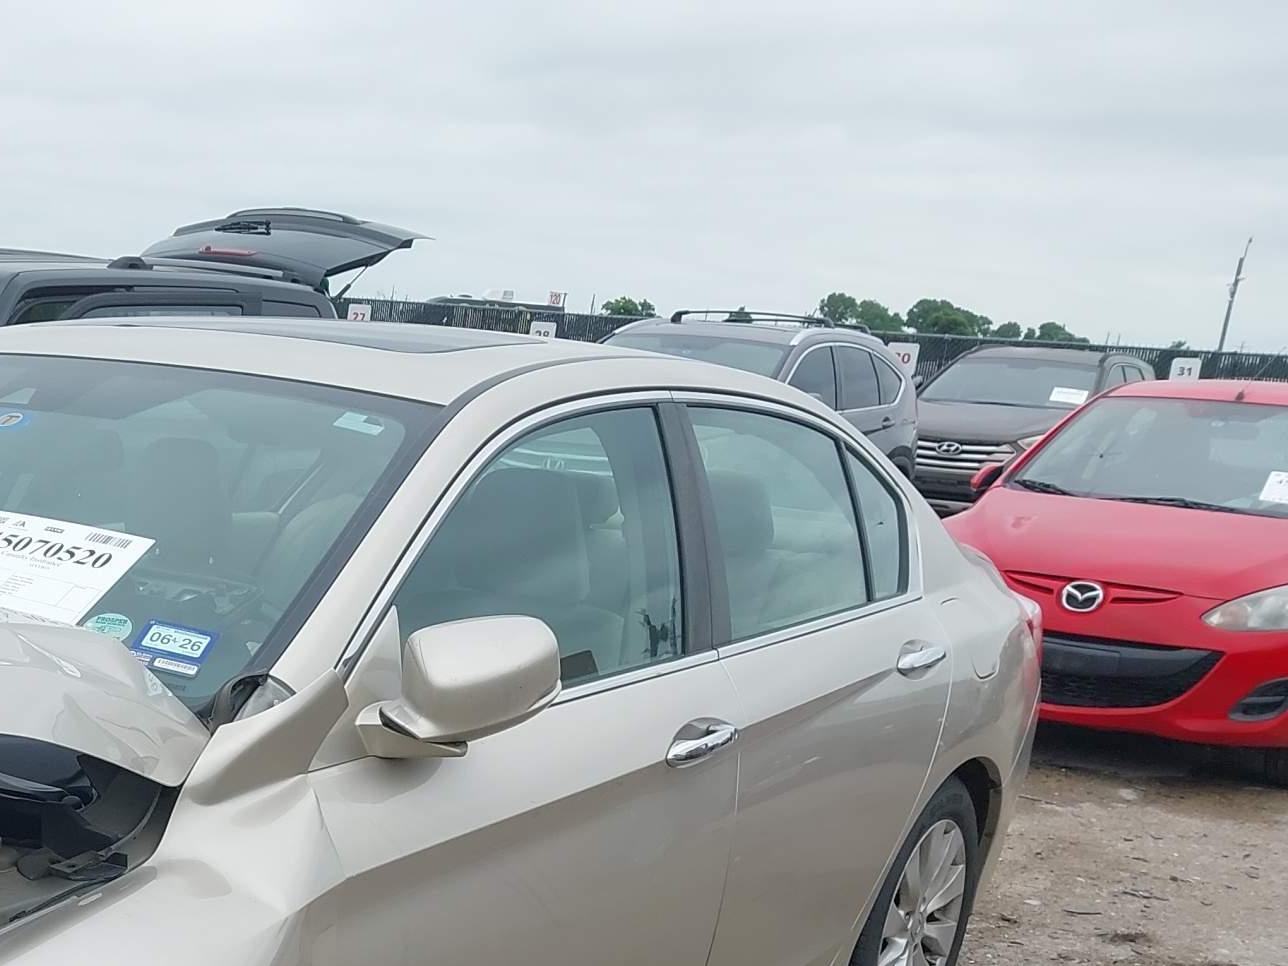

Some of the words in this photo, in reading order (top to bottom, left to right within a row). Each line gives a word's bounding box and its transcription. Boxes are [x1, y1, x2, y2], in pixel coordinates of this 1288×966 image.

[352, 312, 366, 321] 27
[1177, 366, 1192, 376] 31
[149, 631, 174, 645] 06
[178, 638, 204, 652] 26
